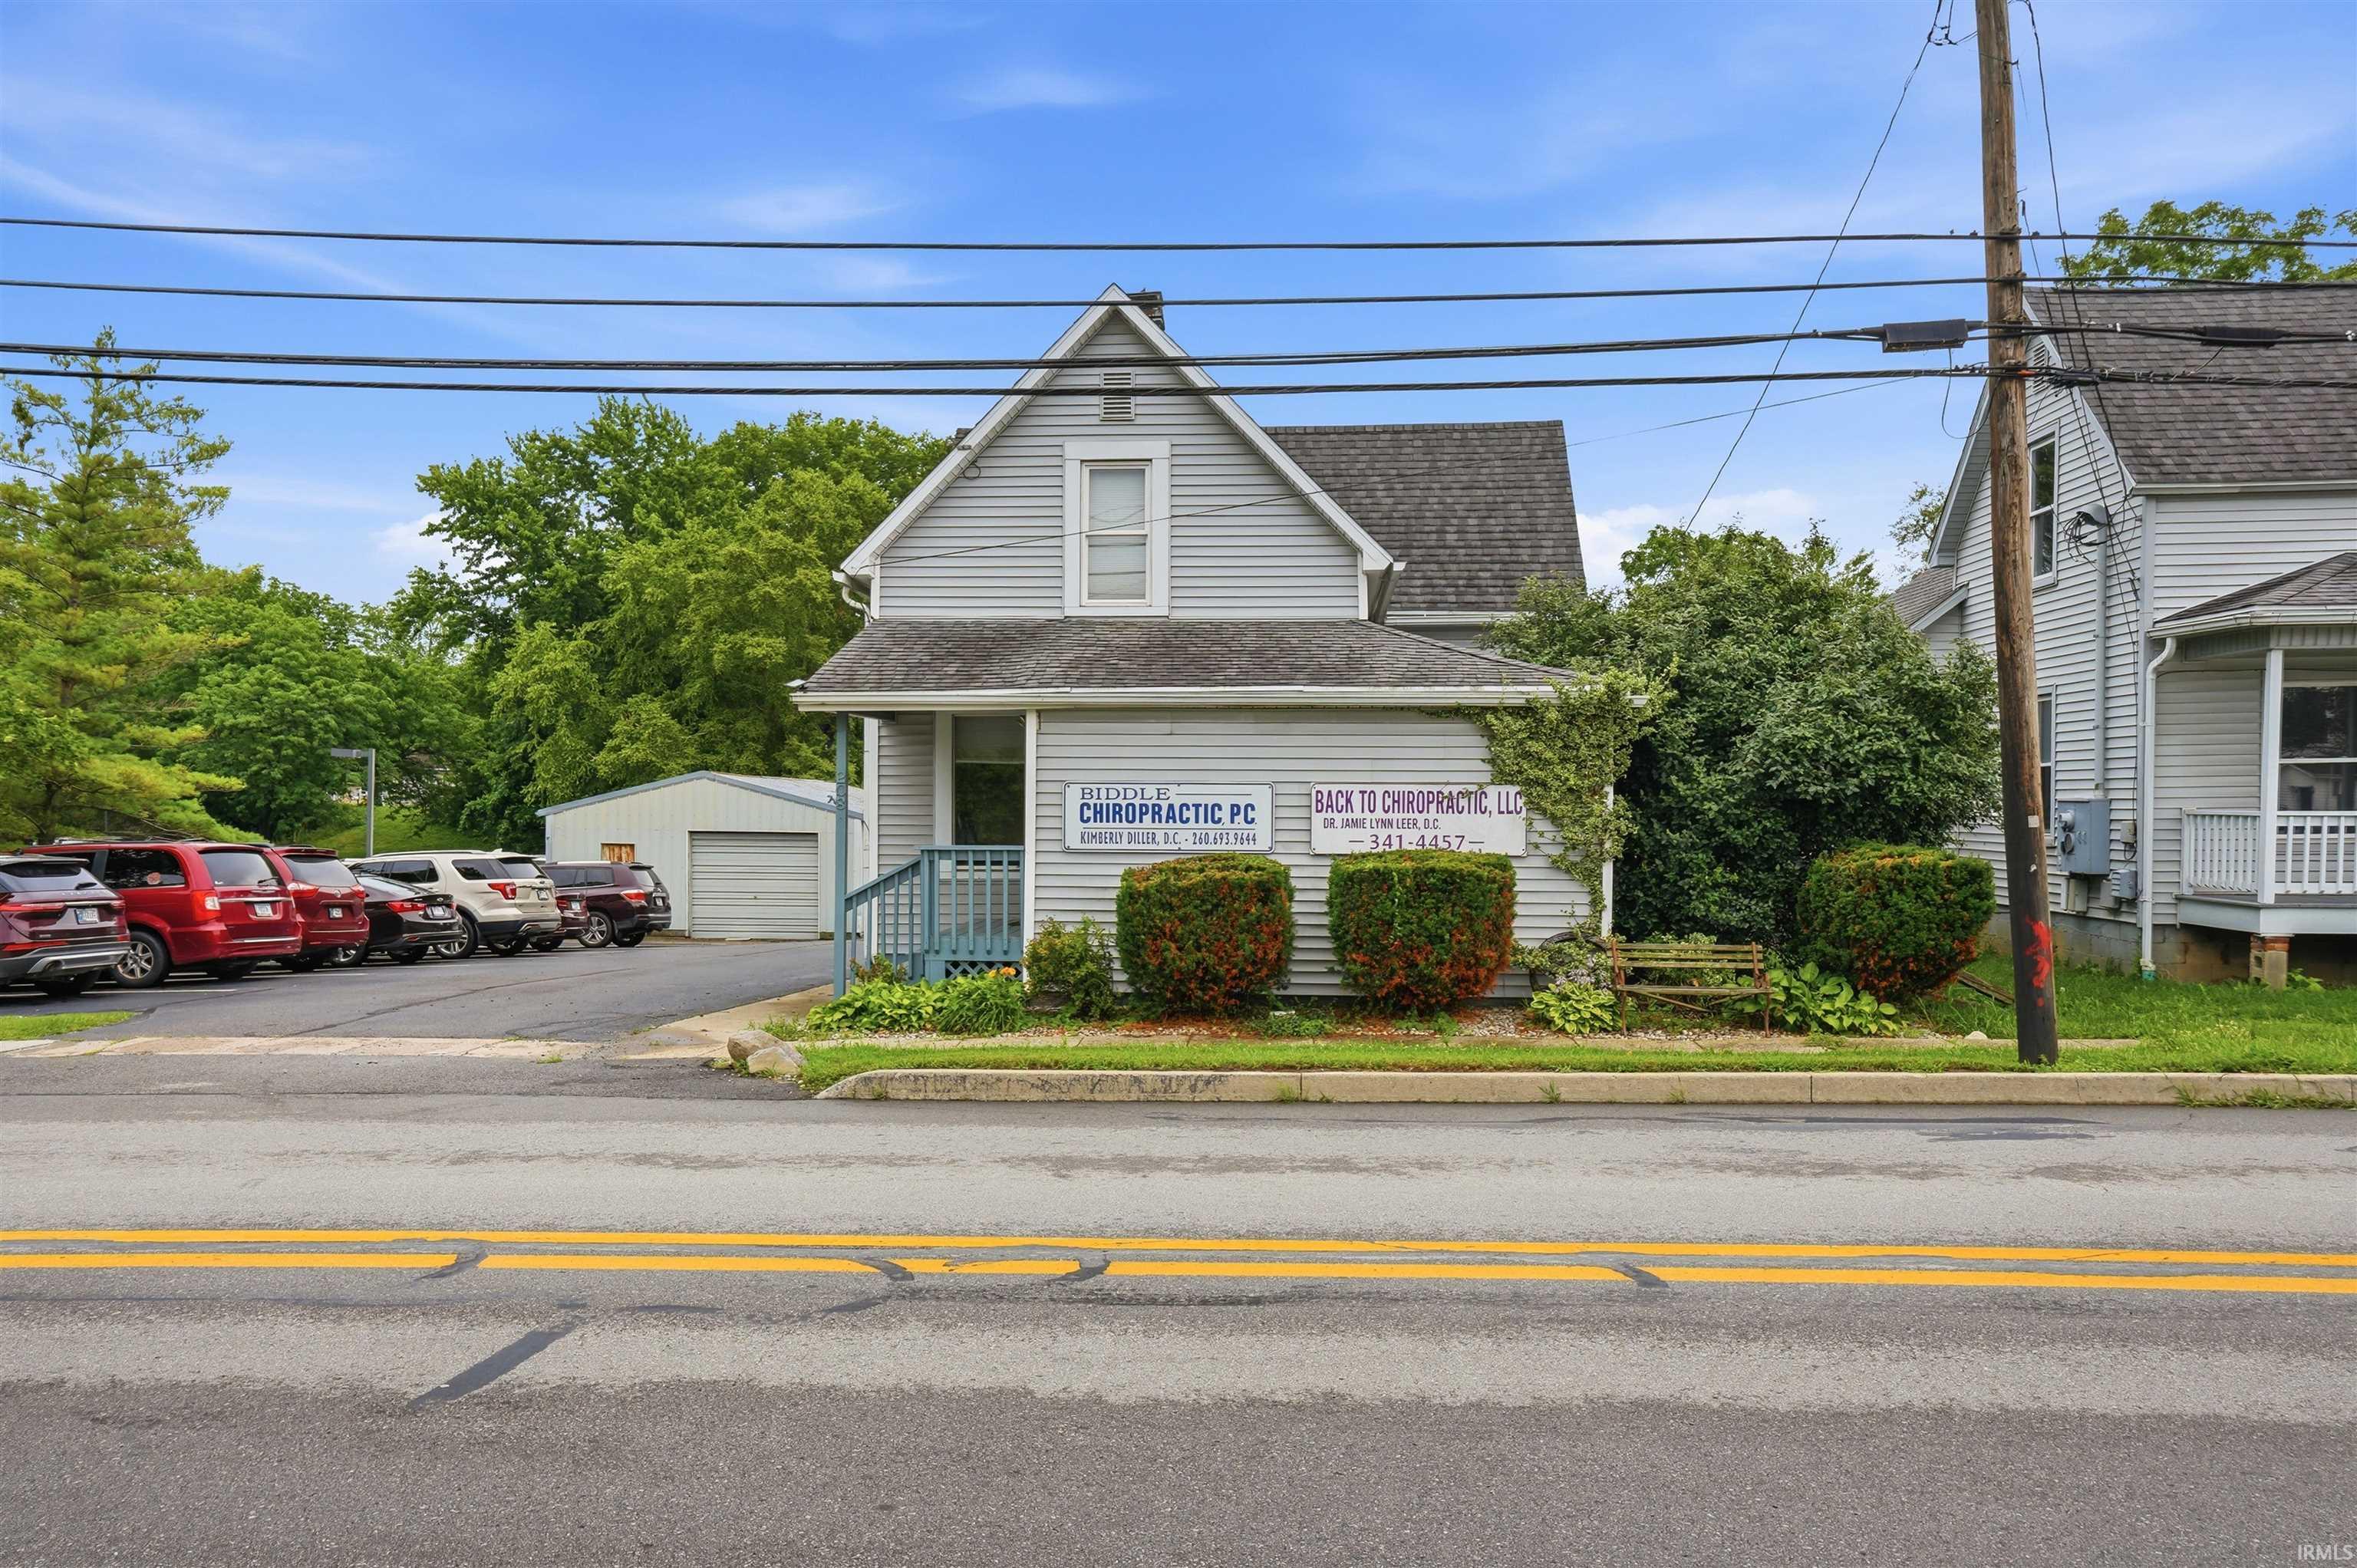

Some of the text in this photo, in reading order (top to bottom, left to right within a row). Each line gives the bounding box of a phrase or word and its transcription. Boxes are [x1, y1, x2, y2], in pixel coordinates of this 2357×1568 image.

[1080, 787, 1172, 801] BIDDLE
[1314, 789, 1523, 818] BACK TO CHIROPRACTIC, LLC
[1079, 802, 1258, 826] CHIROPRACTIC, P.C.
[1323, 817, 1442, 831] DR. JAMIE LYNN LEER, D.C.
[1080, 831, 1124, 845] KIMBERLY
[1127, 831, 1160, 846] DILLER,
[1163, 832, 1182, 845] D.C.
[1192, 832, 1258, 845] 260.693.9644
